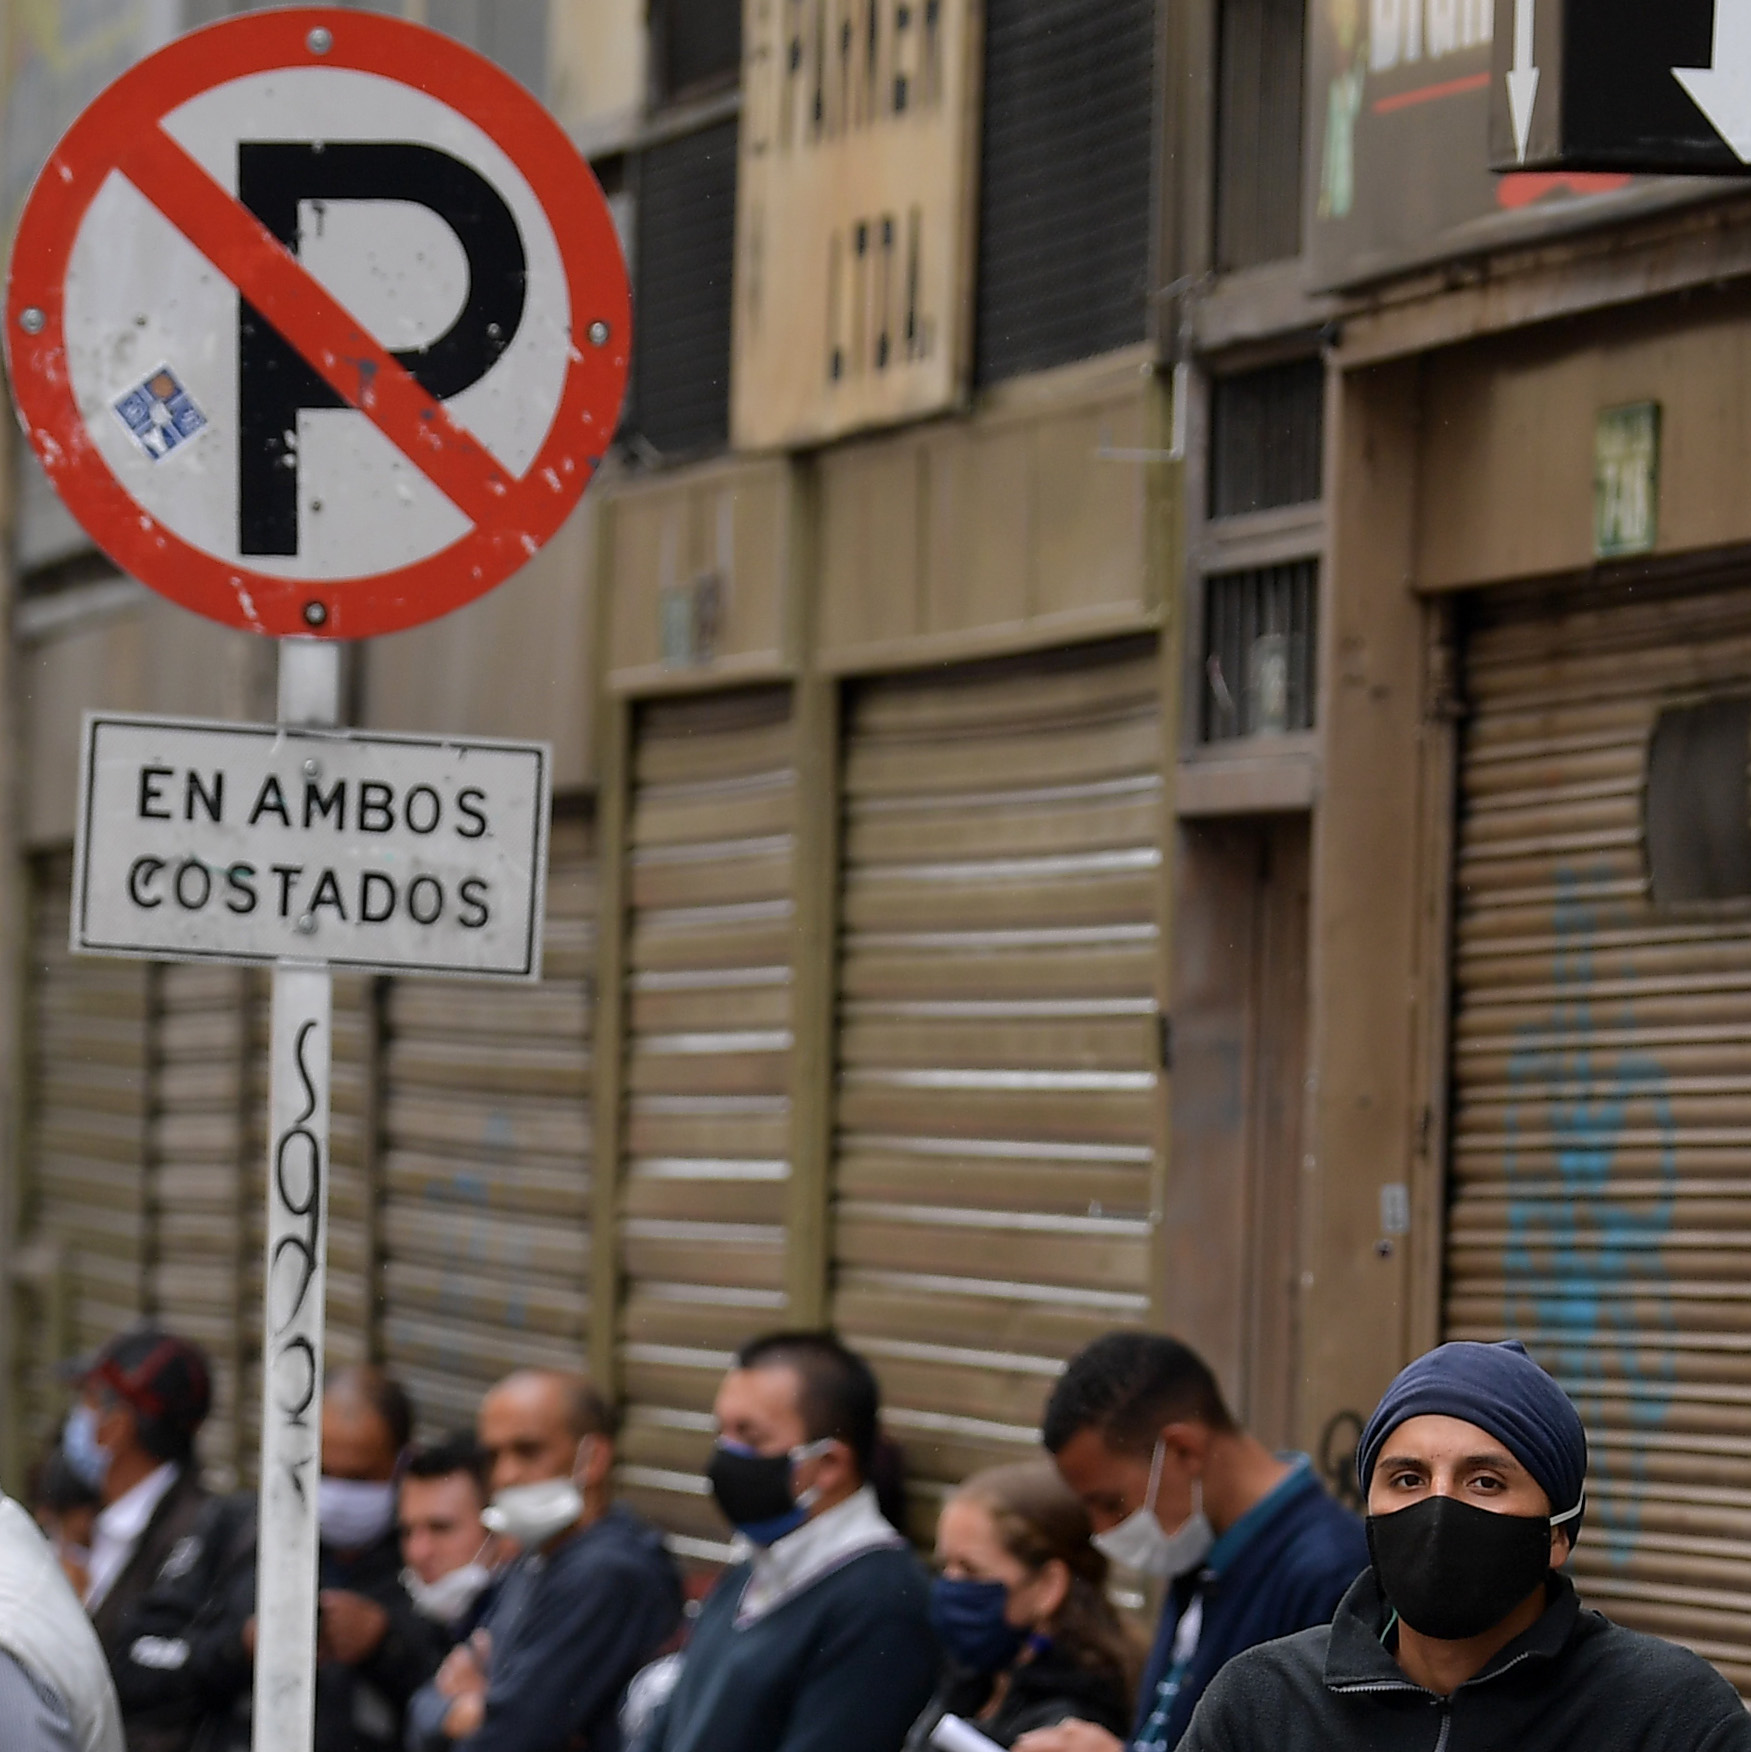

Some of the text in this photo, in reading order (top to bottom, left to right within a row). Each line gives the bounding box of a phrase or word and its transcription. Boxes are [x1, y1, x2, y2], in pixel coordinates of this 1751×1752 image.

[237, 140, 527, 556] P
[138, 766, 488, 839] EN AMBOS
[127, 854, 491, 929] COSTADOS
